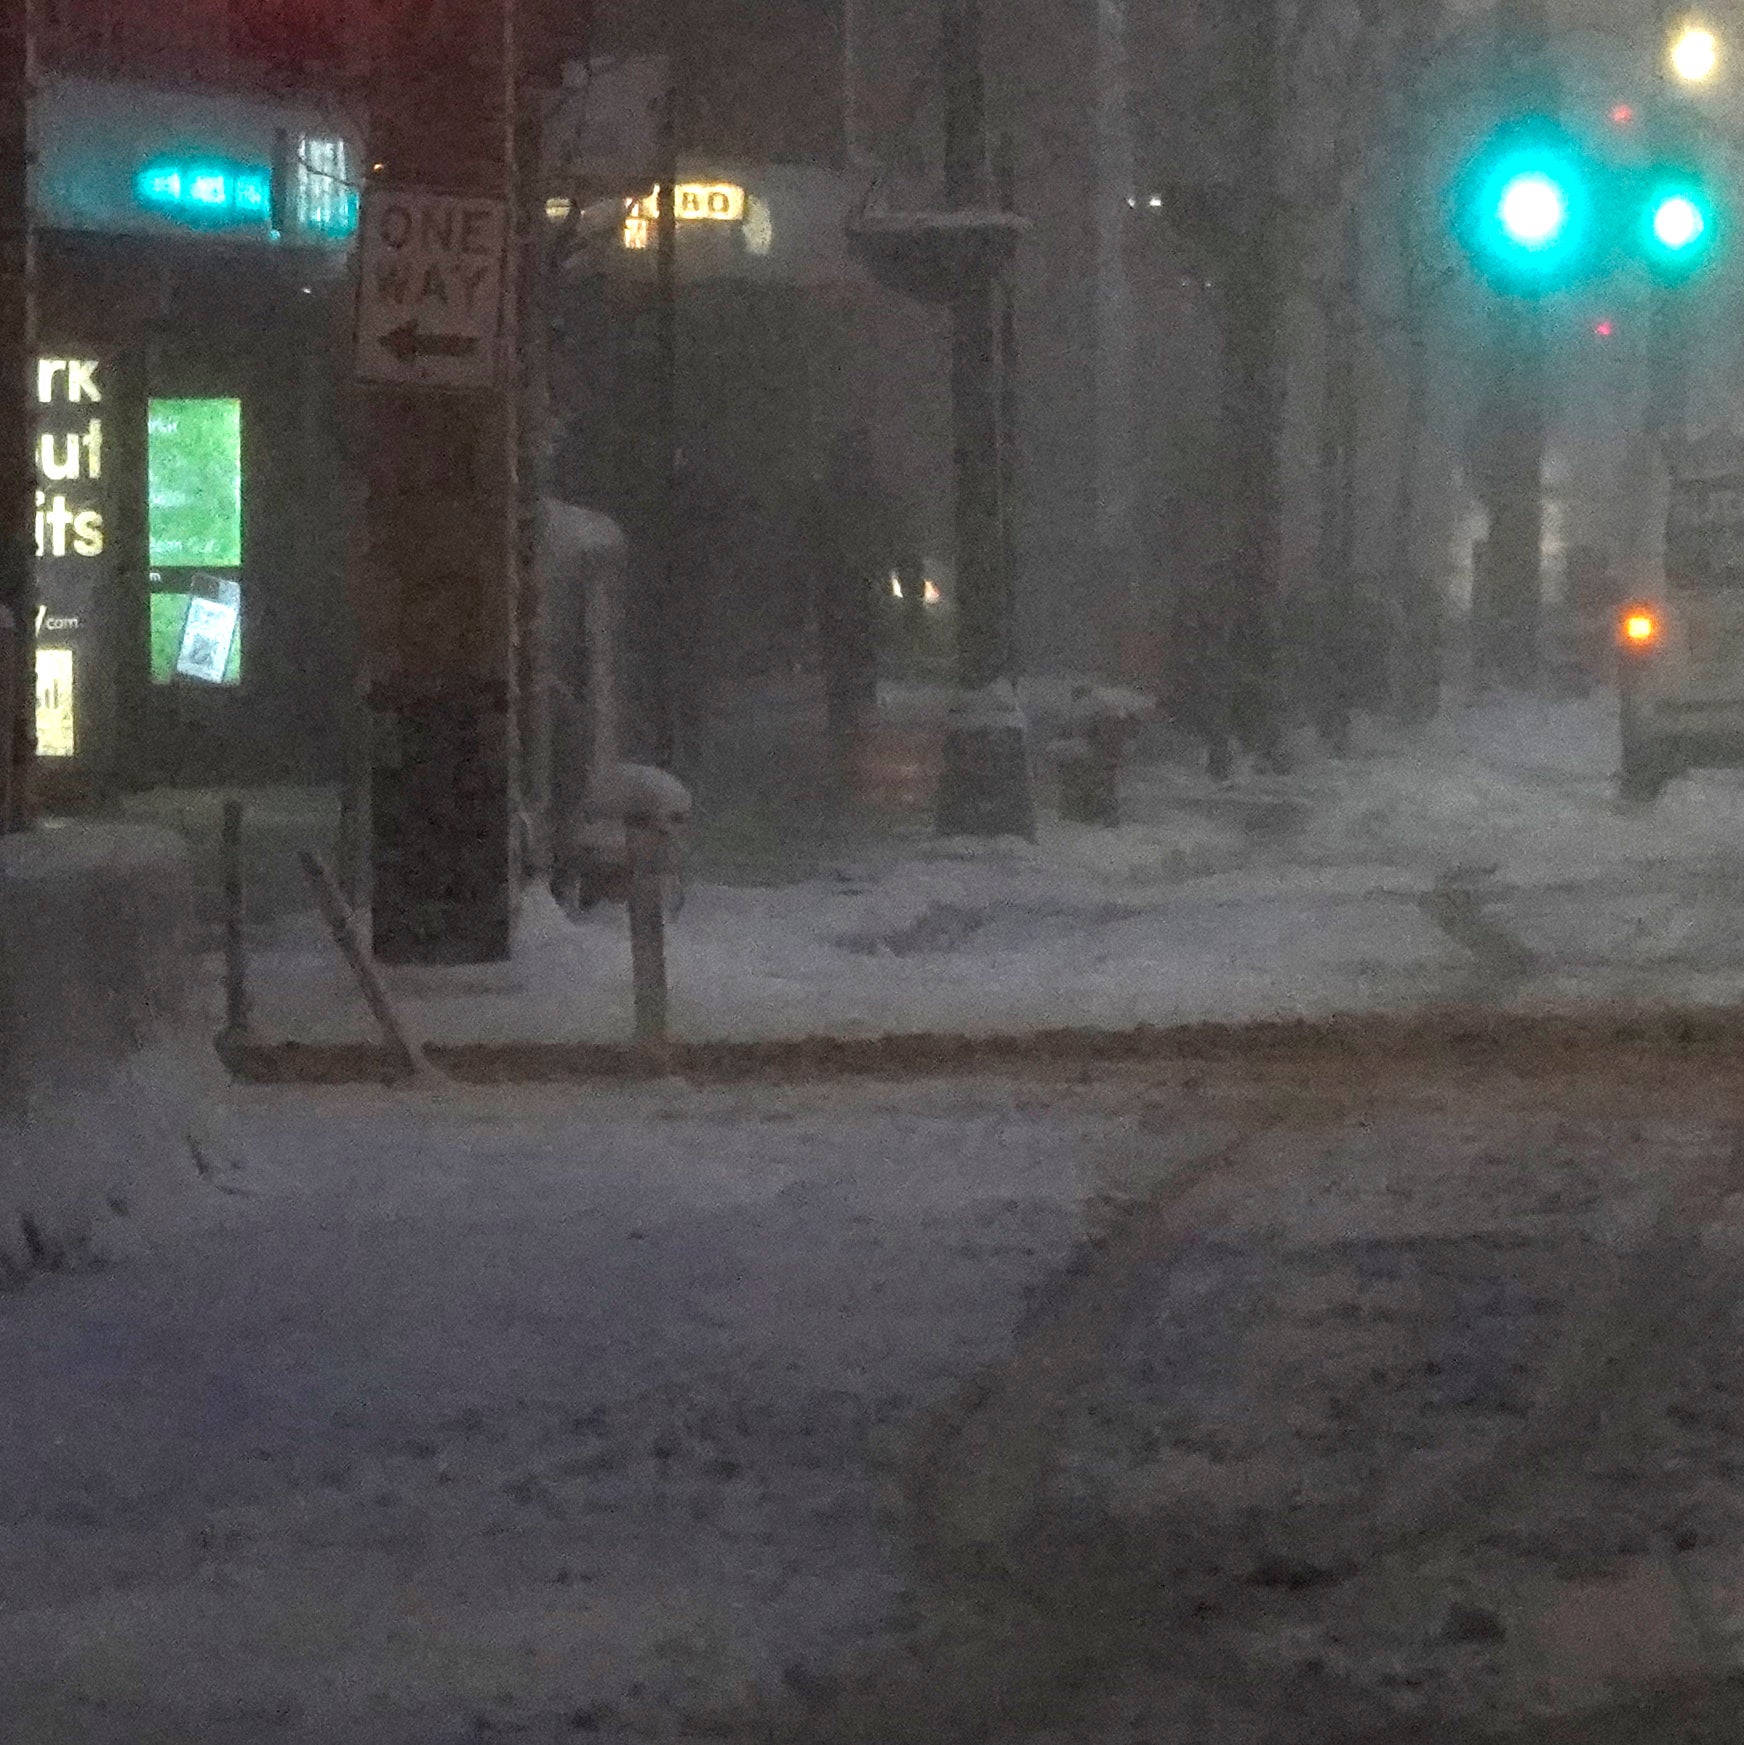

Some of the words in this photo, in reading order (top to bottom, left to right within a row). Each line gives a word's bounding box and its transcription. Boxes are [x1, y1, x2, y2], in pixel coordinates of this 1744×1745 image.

[380, 204, 492, 253] ONE
[376, 261, 489, 312] WAY
[38, 359, 101, 402] rk
